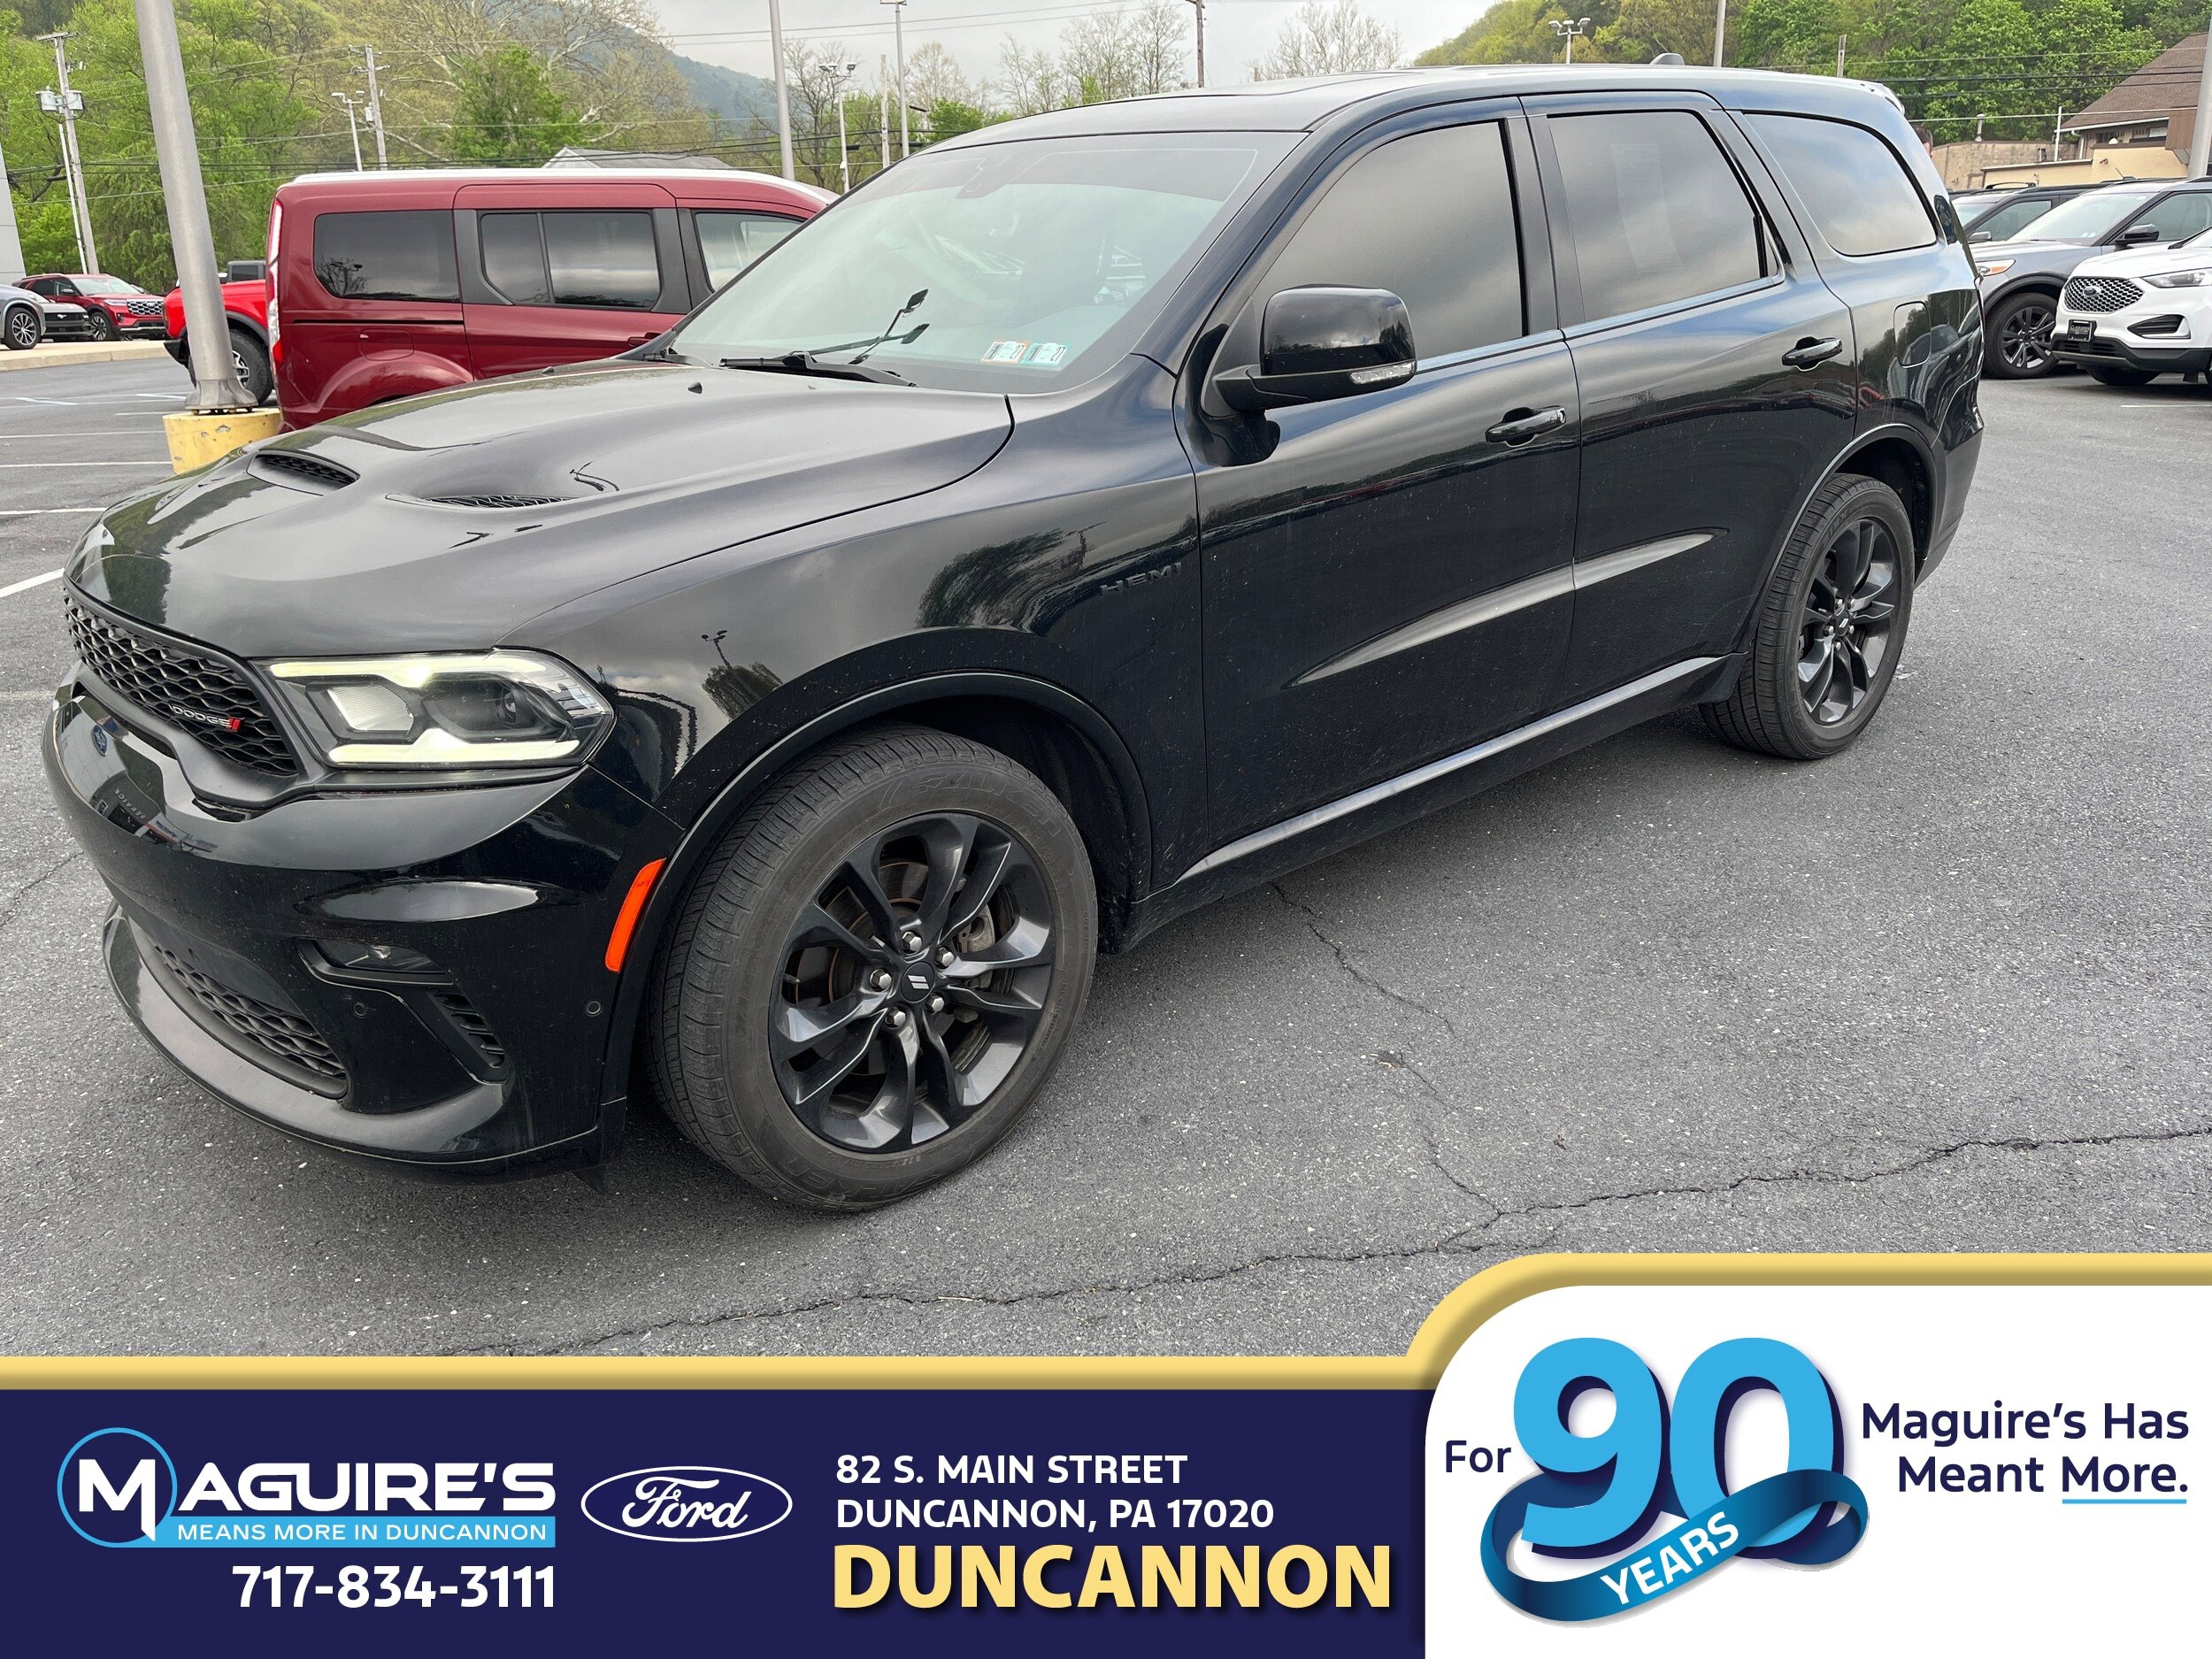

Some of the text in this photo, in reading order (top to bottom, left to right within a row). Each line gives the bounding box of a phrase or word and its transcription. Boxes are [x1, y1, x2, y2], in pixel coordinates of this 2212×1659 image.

[1099, 562, 1182, 596] HEMI
[172, 705, 232, 728] DODGE
[912, 772, 1061, 837] FALKEN
